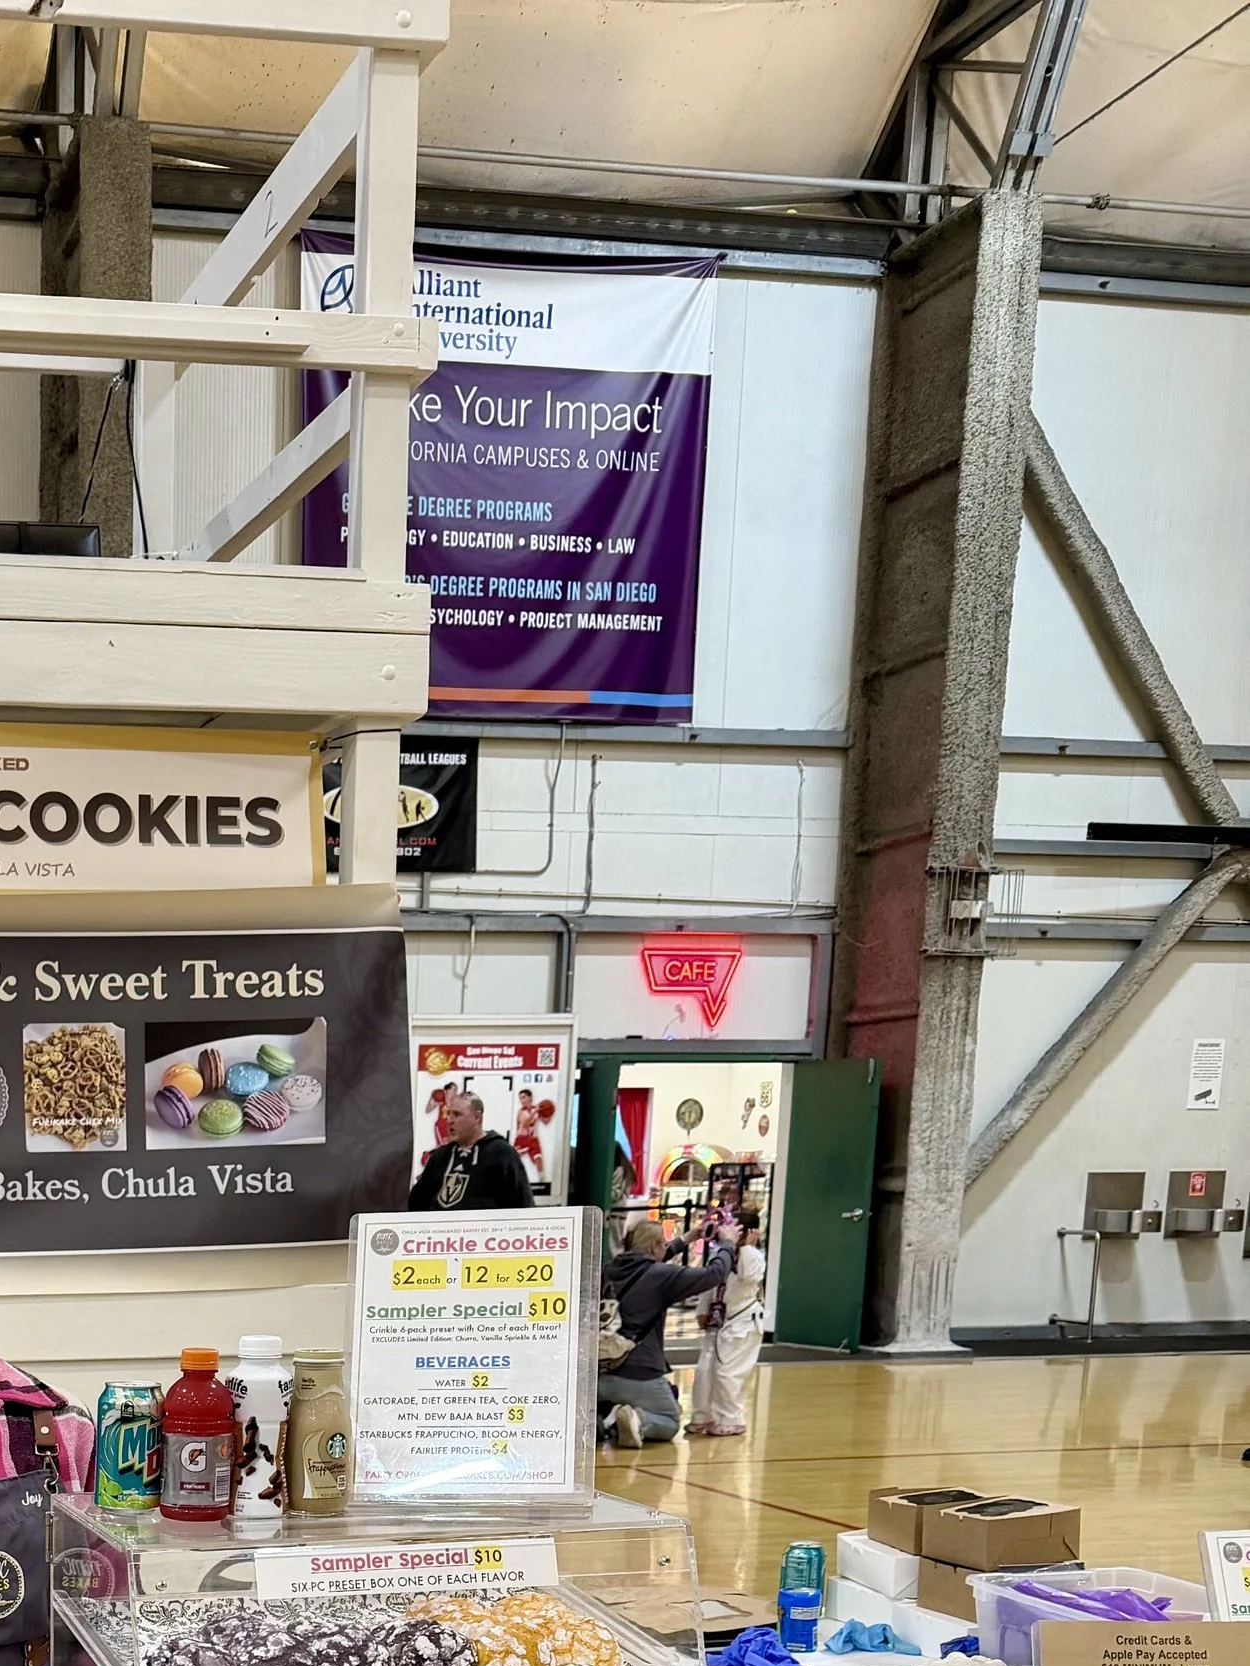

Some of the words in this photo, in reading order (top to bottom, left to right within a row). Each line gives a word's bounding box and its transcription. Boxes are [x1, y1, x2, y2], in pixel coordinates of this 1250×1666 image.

[412, 269, 482, 298] lliant
[412, 302, 554, 330] nternational
[439, 328, 518, 359] versity
[454, 385, 533, 428] Your
[544, 390, 664, 439] Impact
[473, 445, 571, 469] CAMPUSES
[576, 450, 589, 469] &
[596, 450, 661, 473] ONLINE
[418, 496, 472, 519] DEGREE
[476, 500, 553, 523] PROGRAMS
[442, 531, 514, 550] EDUCATION
[530, 535, 592, 554] BUSINESS
[608, 539, 636, 555] LAW
[431, 576, 484, 597] DEGREE
[489, 579, 563, 601] PROGRAMS
[566, 582, 581, 601] IN
[585, 582, 612, 602] SAN
[616, 583, 657, 604] DIEGO
[519, 612, 572, 630] PROJECT
[577, 614, 663, 633] MANAGEMENT
[428, 753, 467, 766] LEAGUES
[26, 863, 76, 877] VISTA
[34, 960, 168, 1002] Sweet
[181, 959, 325, 1000] Treats
[664, 960, 717, 982] CAFE
[101, 1168, 198, 1199] Chula
[208, 1163, 295, 1195] Vista
[446, 1275, 458, 1285] or
[464, 1266, 488, 1284] 12
[496, 1273, 510, 1283] for
[516, 1264, 554, 1284] $20
[528, 1297, 567, 1318] $10
[369, 1325, 398, 1335] Crinkle
[400, 1325, 429, 1336] 6-pack
[430, 1325, 455, 1335] preset
[457, 1324, 474, 1333] with
[477, 1324, 495, 1333] One
[498, 1323, 507, 1332] of
[509, 1324, 529, 1332] each
[415, 1355, 511, 1368] BEVERAGES
[435, 1379, 466, 1388] WATER
[472, 1375, 489, 1388] $2
[363, 1396, 418, 1406] GATORADE,
[421, 1396, 441, 1405] DIET
[443, 1396, 476, 1405] GREEN
[479, 1396, 499, 1406] TEA,
[502, 1396, 530, 1405] COKE
[532, 1395, 561, 1405] ZERO,
[398, 1412, 421, 1421] MTN.
[424, 1412, 447, 1421] DEW
[449, 1412, 474, 1421] BAJA
[476, 1412, 504, 1421] BLAST
[508, 1408, 525, 1421] $3
[359, 1430, 413, 1440] STARBUCKS
[415, 1430, 478, 1440] FRAPPUCINO,
[481, 1430, 518, 1439] BLOOM
[520, 1429, 563, 1440] ENERGY,
[410, 1446, 448, 1455] FAIRLIFE
[310, 1551, 393, 1574] Sampler
[399, 1549, 469, 1570] Special
[474, 1549, 503, 1566] $10
[291, 1580, 326, 1593] SIX-PC
[329, 1579, 367, 1591] PRESET
[370, 1577, 394, 1589] BOX
[397, 1576, 422, 1587] ONE
[427, 1575, 442, 1586] OF
[447, 1573, 478, 1585] EACH
[481, 1571, 525, 1583] FLAVOR
[1116, 1635, 1148, 1645] Credit
[1150, 1635, 1181, 1645] Cards
[1184, 1635, 1192, 1645] &
[1103, 1650, 1133, 1661] Apple
[1136, 1650, 1155, 1661] Pay
[1158, 1650, 1207, 1661] Accepted
